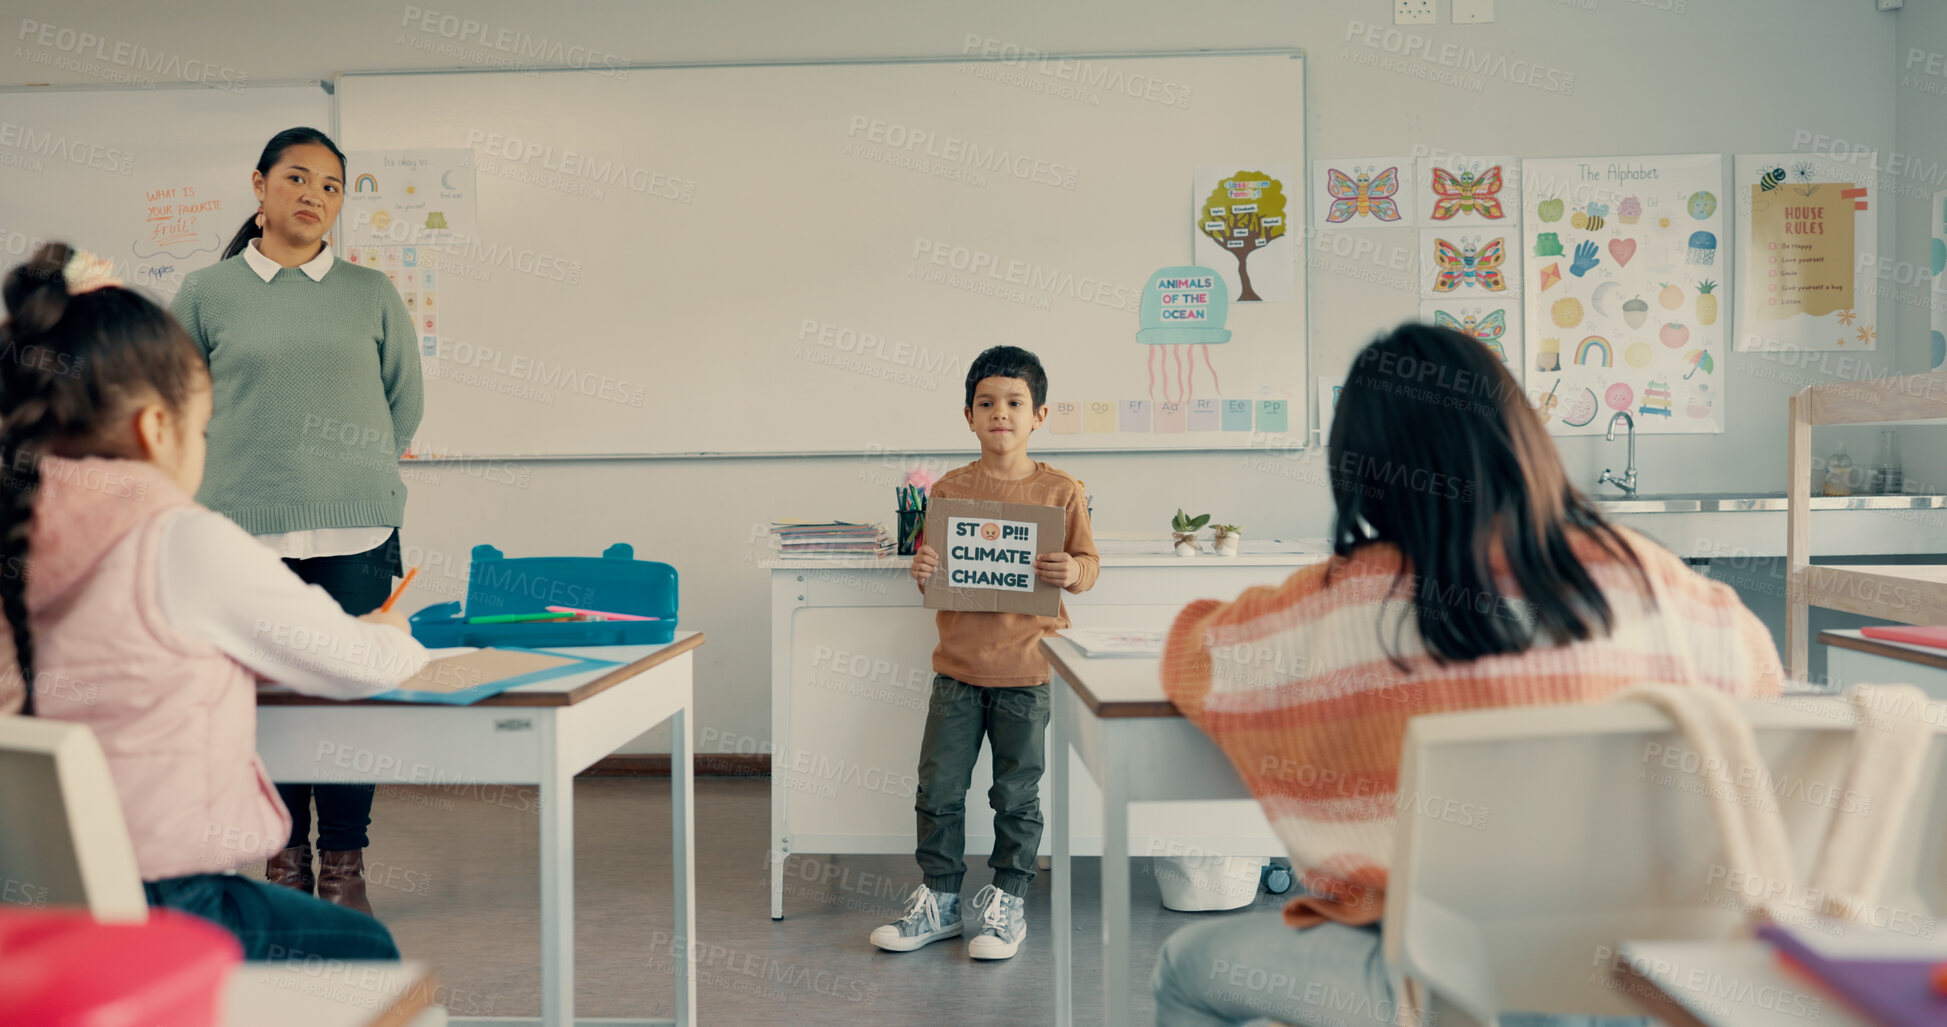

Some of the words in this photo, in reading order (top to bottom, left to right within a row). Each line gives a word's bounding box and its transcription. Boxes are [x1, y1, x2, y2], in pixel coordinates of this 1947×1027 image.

[1578, 163, 1600, 181] The
[1607, 164, 1659, 187] Alphabet
[146, 189, 176, 202] WHAT
[182, 186, 196, 198] IS
[147, 204, 173, 218] YOUR
[1785, 206, 1824, 220] HOUSE
[1785, 221, 1824, 235] RULES
[1158, 279, 1212, 289] ANIMALS
[1162, 294, 1180, 304] OF
[1182, 293, 1207, 304] THE
[1162, 309, 1205, 320] OCEAN
[951, 545, 1031, 565] CLIMATE
[951, 569, 1029, 588] CHANGE
